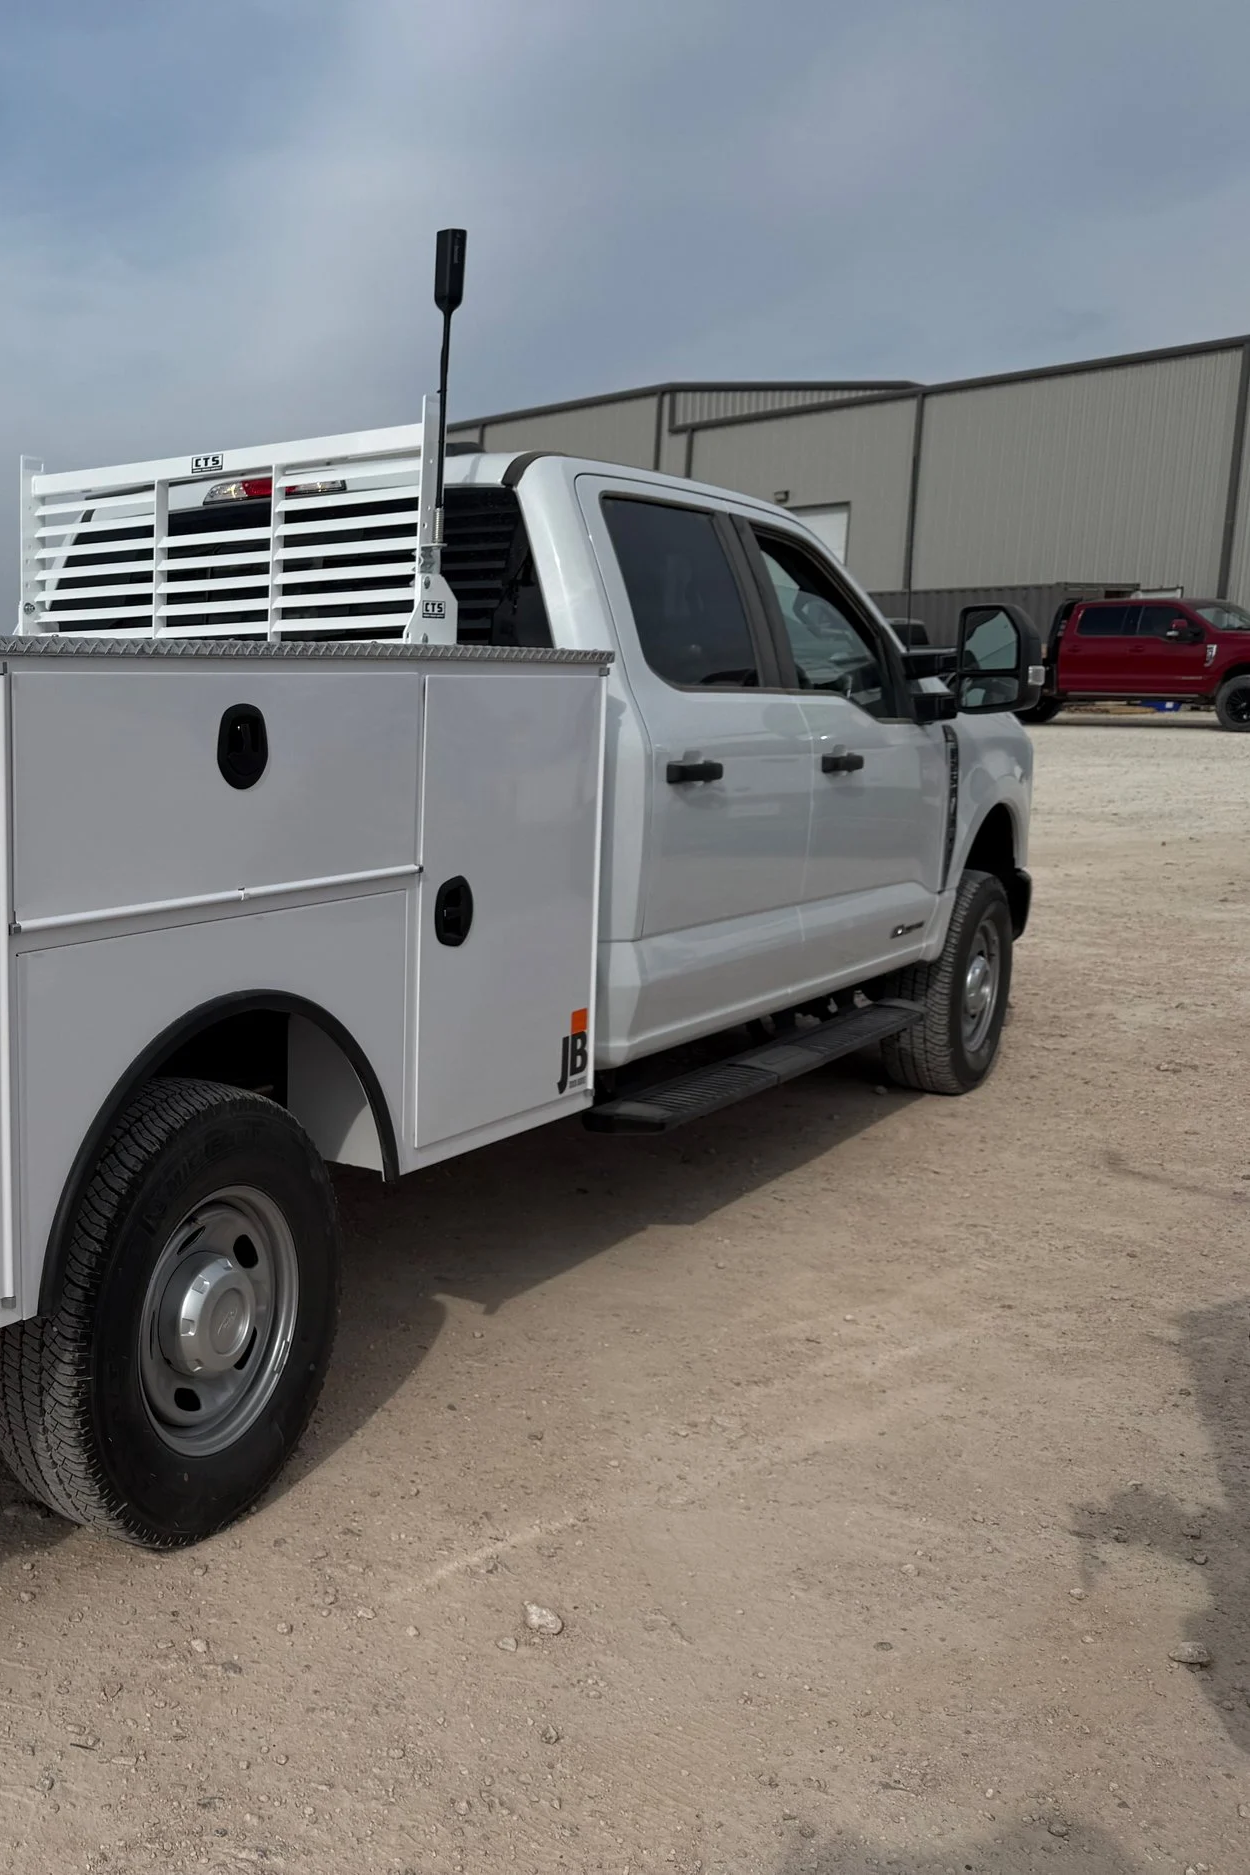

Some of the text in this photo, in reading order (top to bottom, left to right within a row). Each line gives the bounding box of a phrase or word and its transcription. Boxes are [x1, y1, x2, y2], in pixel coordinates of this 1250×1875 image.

[195, 456, 220, 467] CTS
[425, 602, 443, 612] CTS
[557, 1031, 588, 1095] JB
